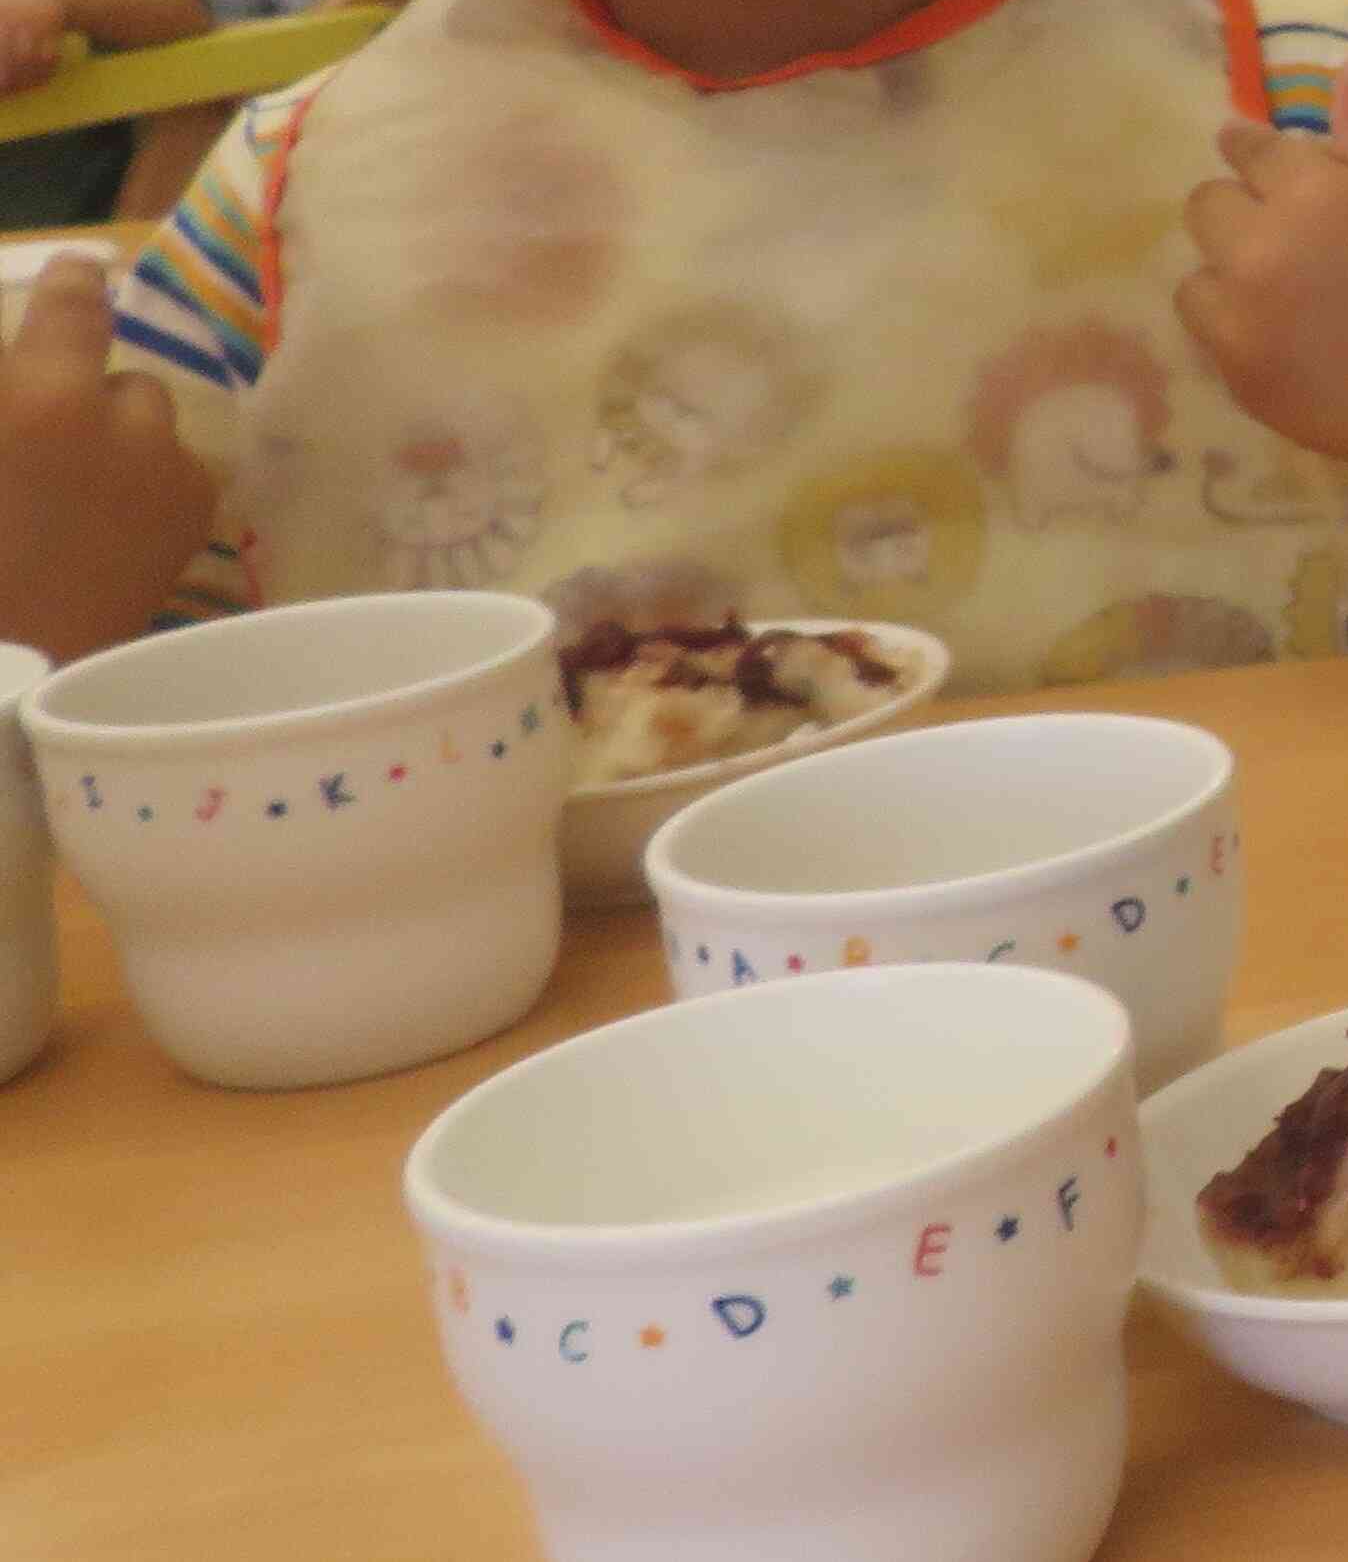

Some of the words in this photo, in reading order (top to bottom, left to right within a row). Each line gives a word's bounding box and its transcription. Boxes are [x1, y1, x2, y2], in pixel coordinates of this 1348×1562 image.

[318, 772, 356, 811] K
[1111, 894, 1146, 933] D
[558, 1319, 590, 1363] C
[710, 1293, 767, 1337] D
[912, 1223, 952, 1277] E
[1056, 1176, 1080, 1232] F
